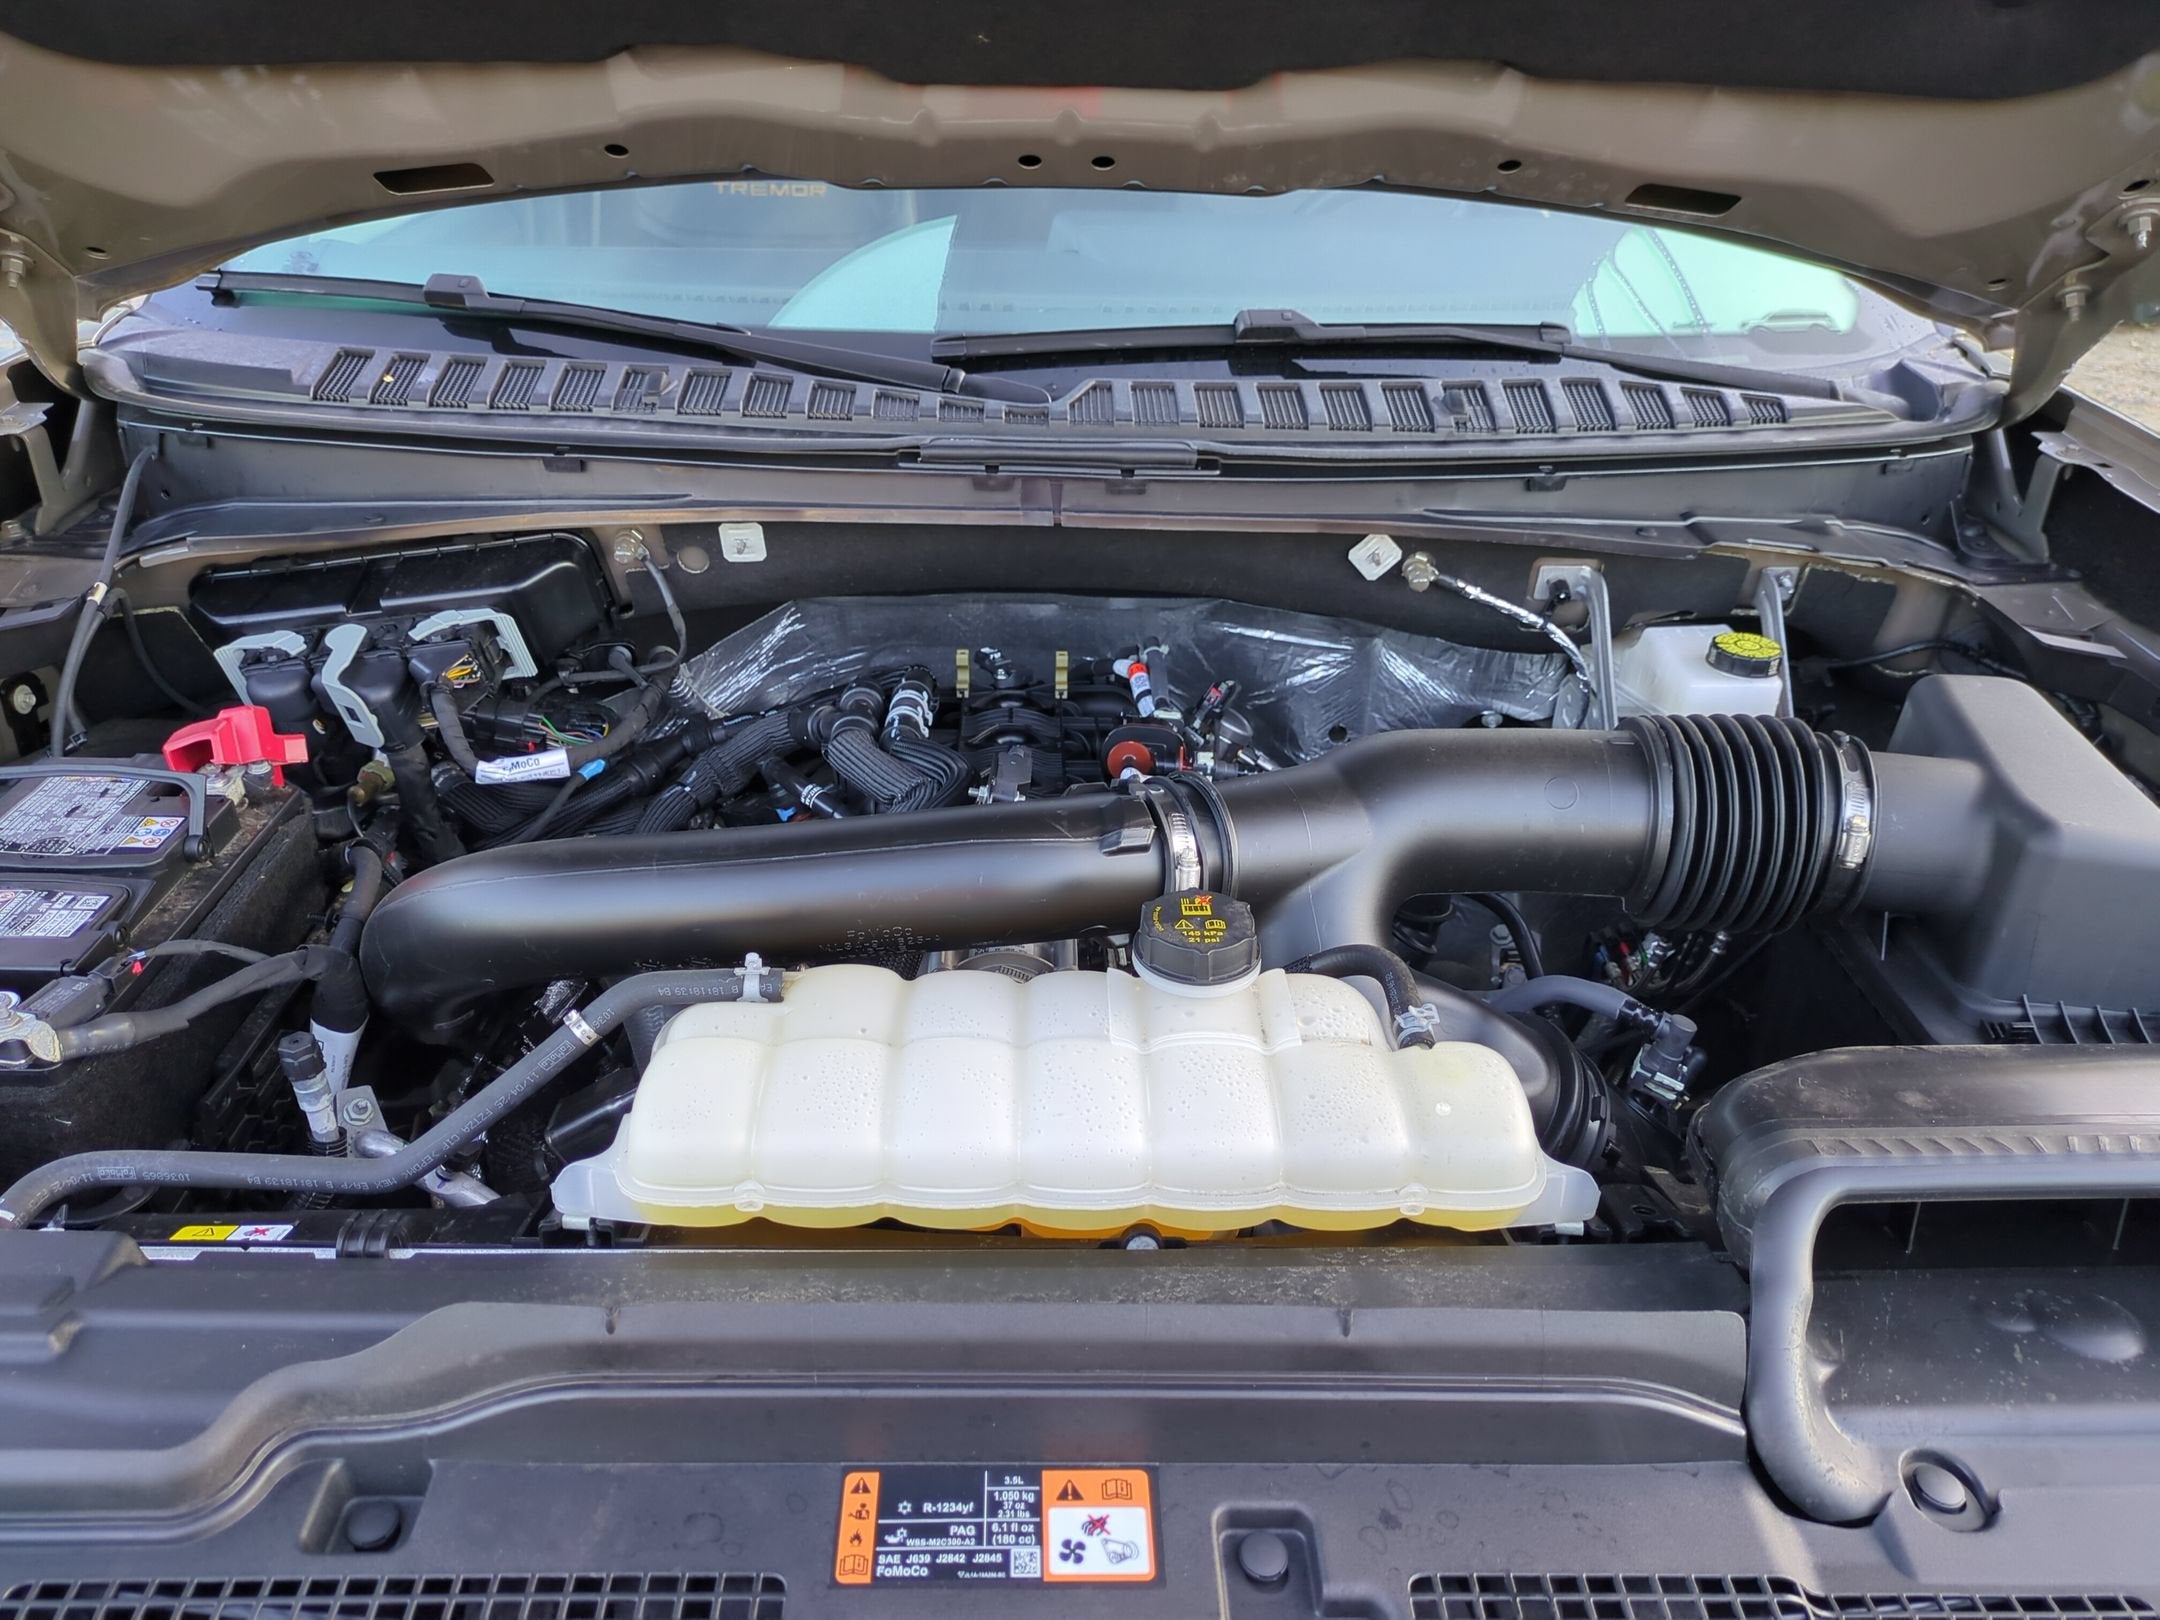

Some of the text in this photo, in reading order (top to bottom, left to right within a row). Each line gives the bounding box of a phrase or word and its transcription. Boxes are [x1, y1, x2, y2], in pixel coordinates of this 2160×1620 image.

[713, 181, 827, 198] TREMOR
[502, 757, 541, 772] MoCo
[591, 1007, 617, 1031] 1036
[494, 1071, 540, 1109] 11/04/25
[1004, 1475, 1024, 1485] 3.5L
[994, 1491, 1035, 1503] 1.050 kg
[922, 1502, 974, 1515] R-1234yf
[1003, 1502, 1013, 1510] 37
[998, 1510, 1030, 1518] 2.31 lbs
[949, 1525, 976, 1536] PAG
[991, 1523, 1035, 1533] 6.1 fl oz
[992, 1534, 1035, 1545] (180 cc)
[878, 1554, 901, 1564] SAE
[906, 1554, 931, 1563] J639
[936, 1554, 966, 1563] J2842
[876, 1566, 928, 1577] FoMoCo
